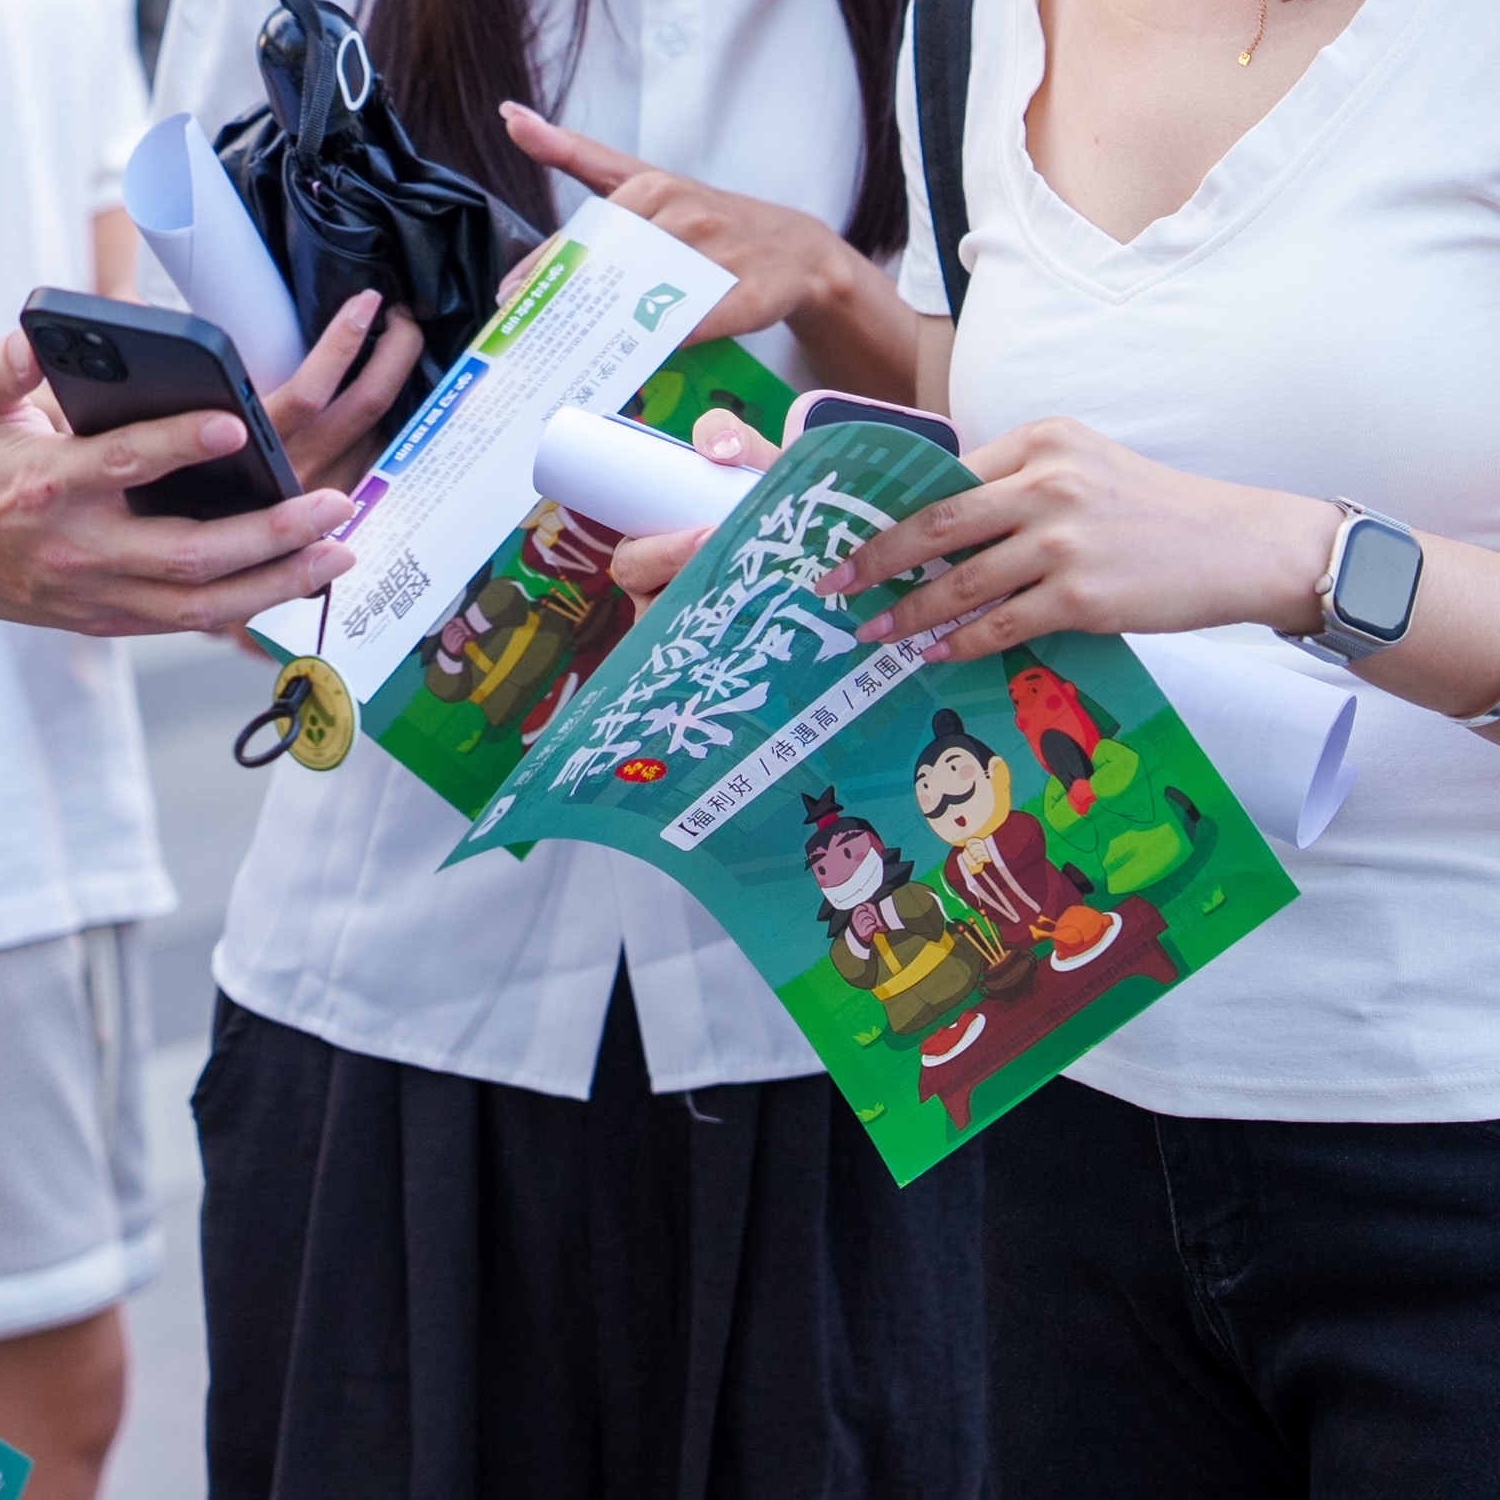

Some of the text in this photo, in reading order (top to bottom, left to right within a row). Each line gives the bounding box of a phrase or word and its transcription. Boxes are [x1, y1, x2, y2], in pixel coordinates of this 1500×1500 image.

[498, 260, 566, 337] 学科教师
[391, 368, 474, 464] 学习管理师
[540, 327, 626, 424] HOUXUE EDUCATION
[341, 547, 418, 638] 招聘会
[389, 570, 431, 620] 校园
